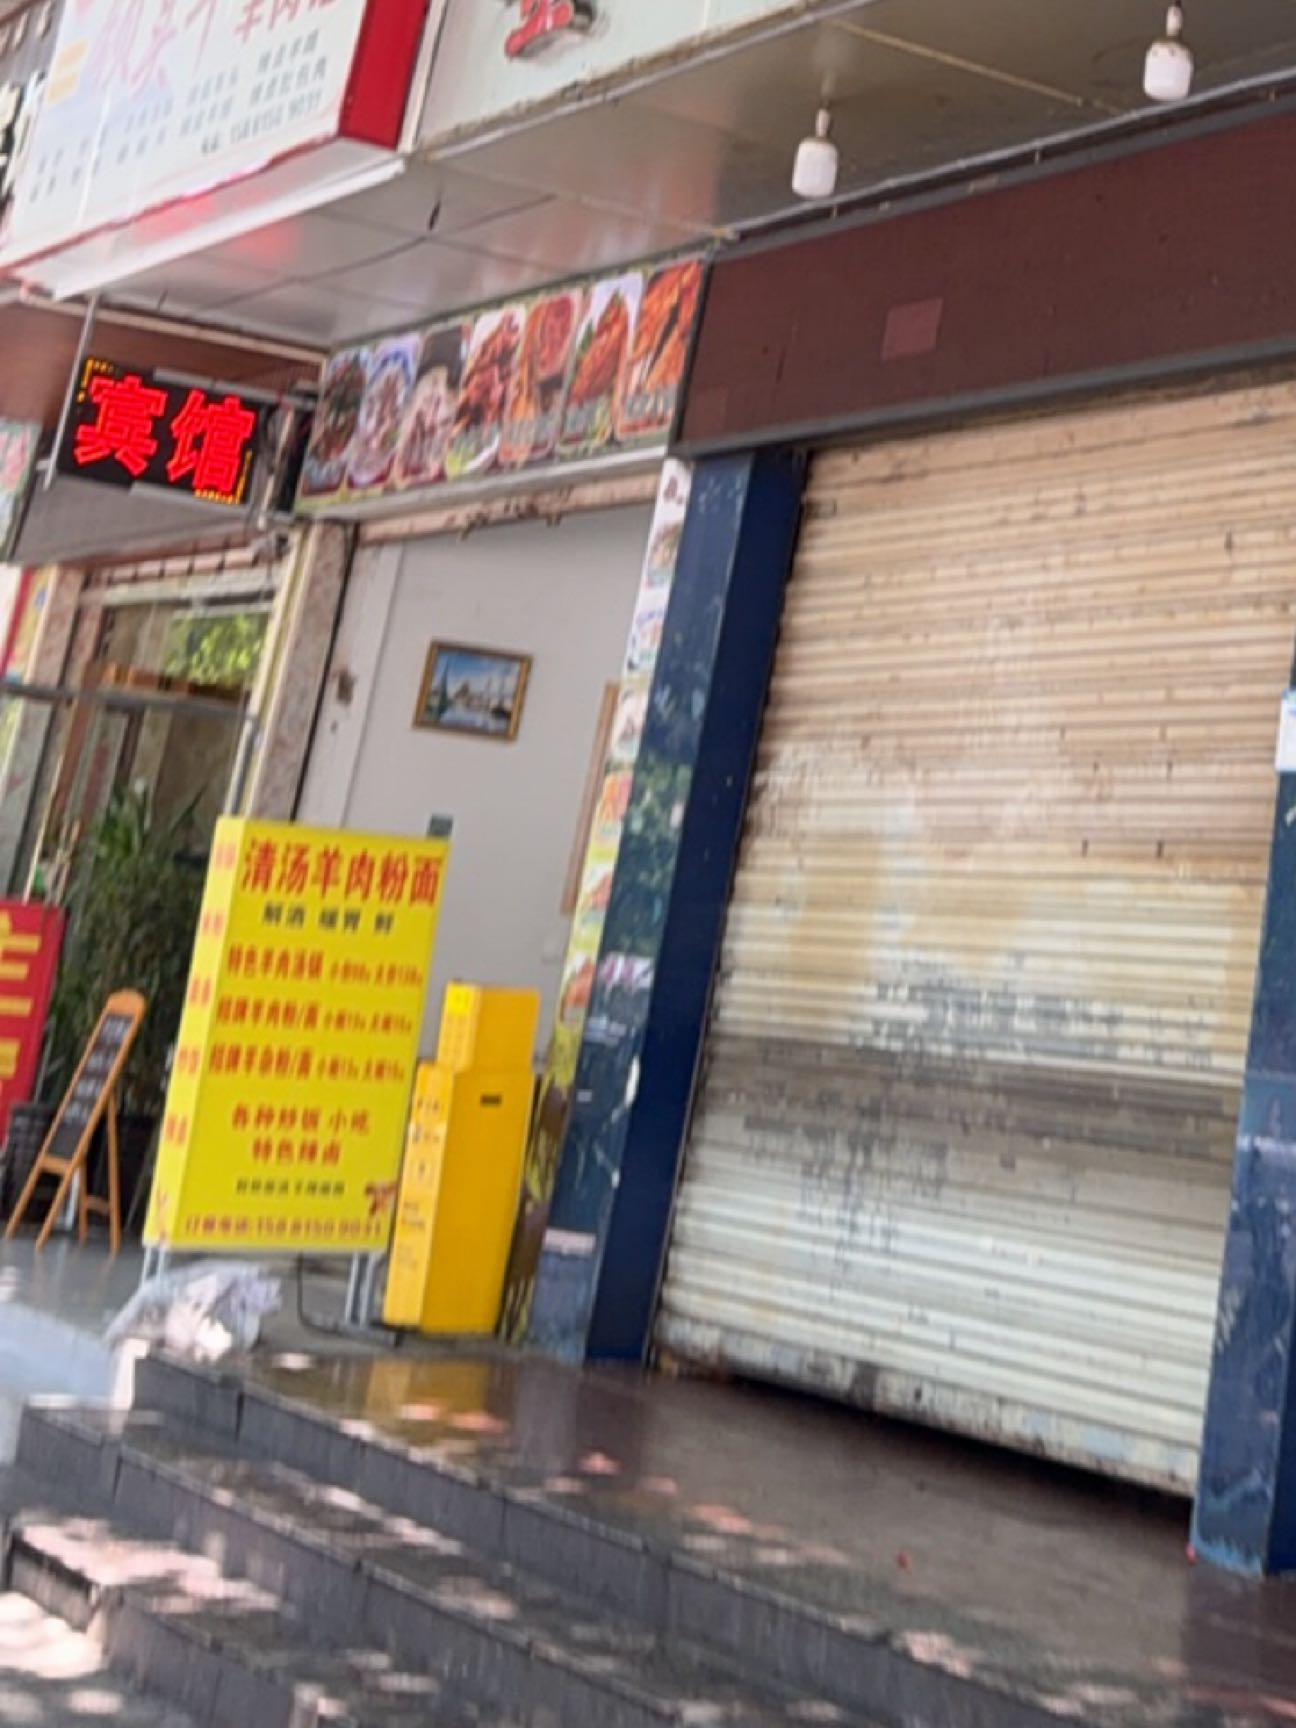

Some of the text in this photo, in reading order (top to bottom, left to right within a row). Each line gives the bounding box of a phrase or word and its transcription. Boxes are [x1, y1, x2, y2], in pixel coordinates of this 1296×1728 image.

[74, 375, 256, 493] 宾馆
[242, 839, 442, 905] 清汤羊肉粉面
